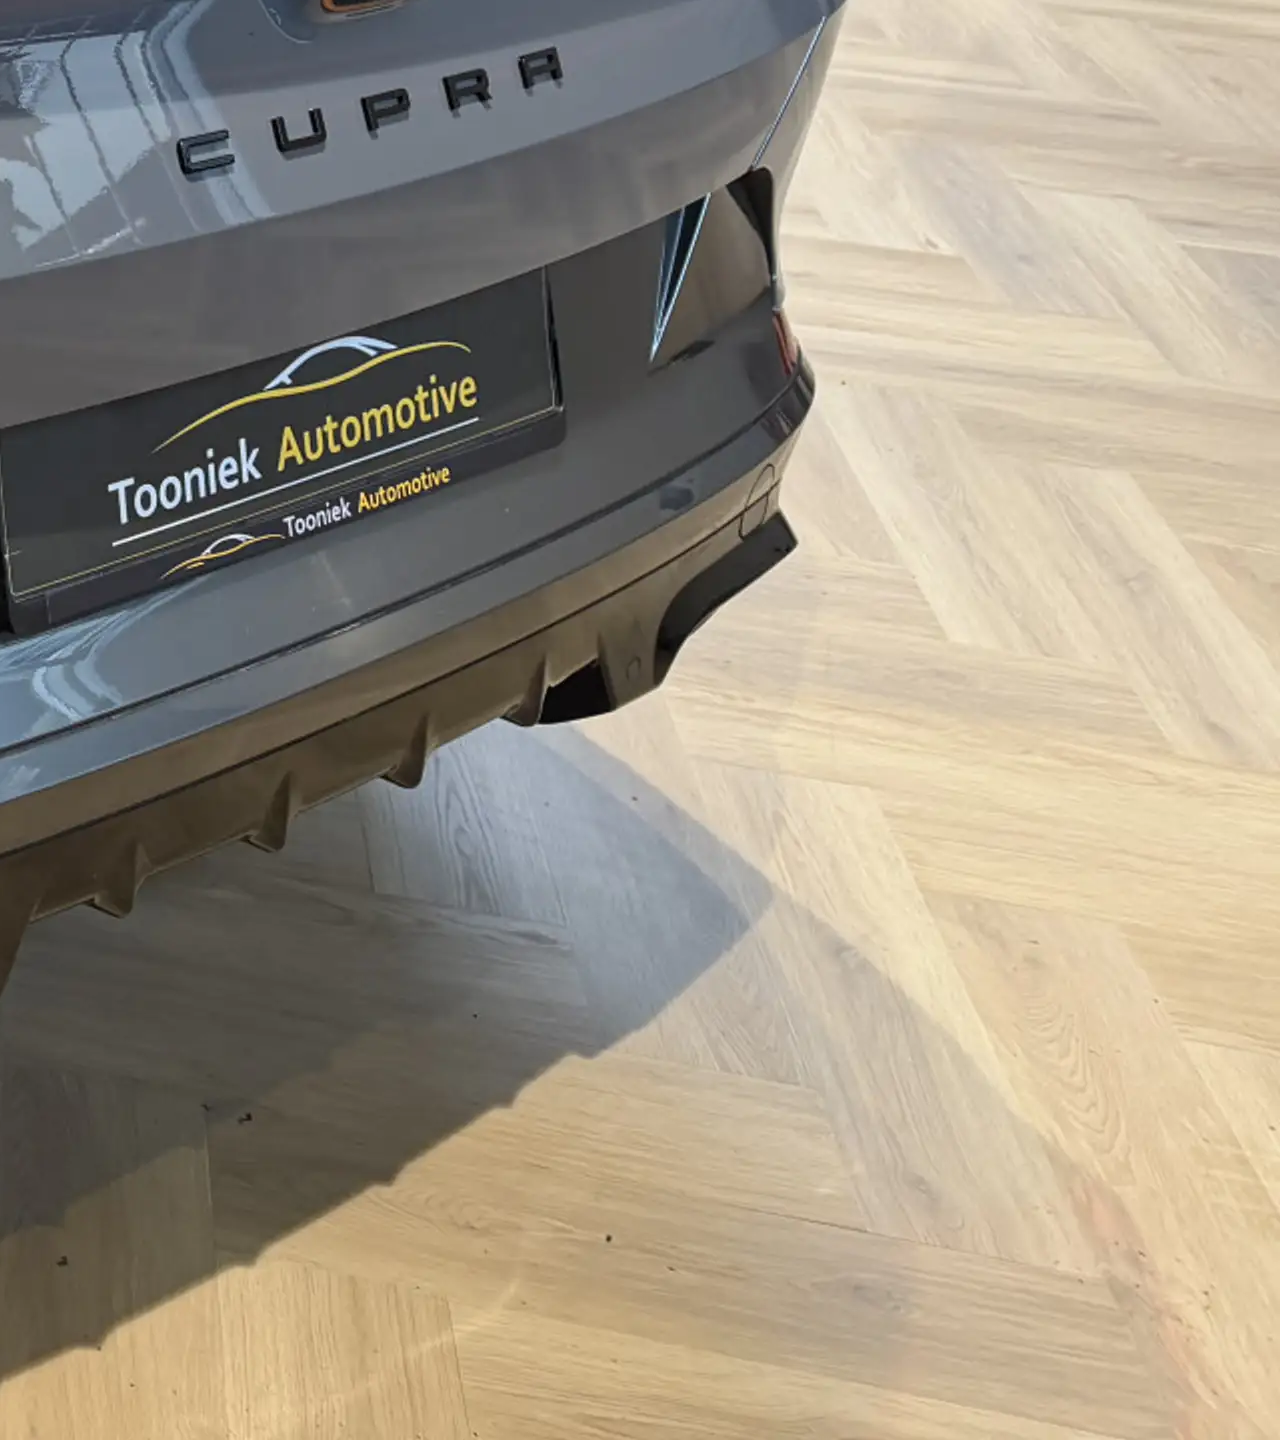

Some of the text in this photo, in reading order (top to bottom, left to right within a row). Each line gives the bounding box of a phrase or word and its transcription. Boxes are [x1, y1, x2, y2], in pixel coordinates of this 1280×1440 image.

[176, 46, 563, 175] CUPRA
[108, 374, 478, 525] Tooniek Automotive
[283, 465, 451, 538] Tooniek Automotive
